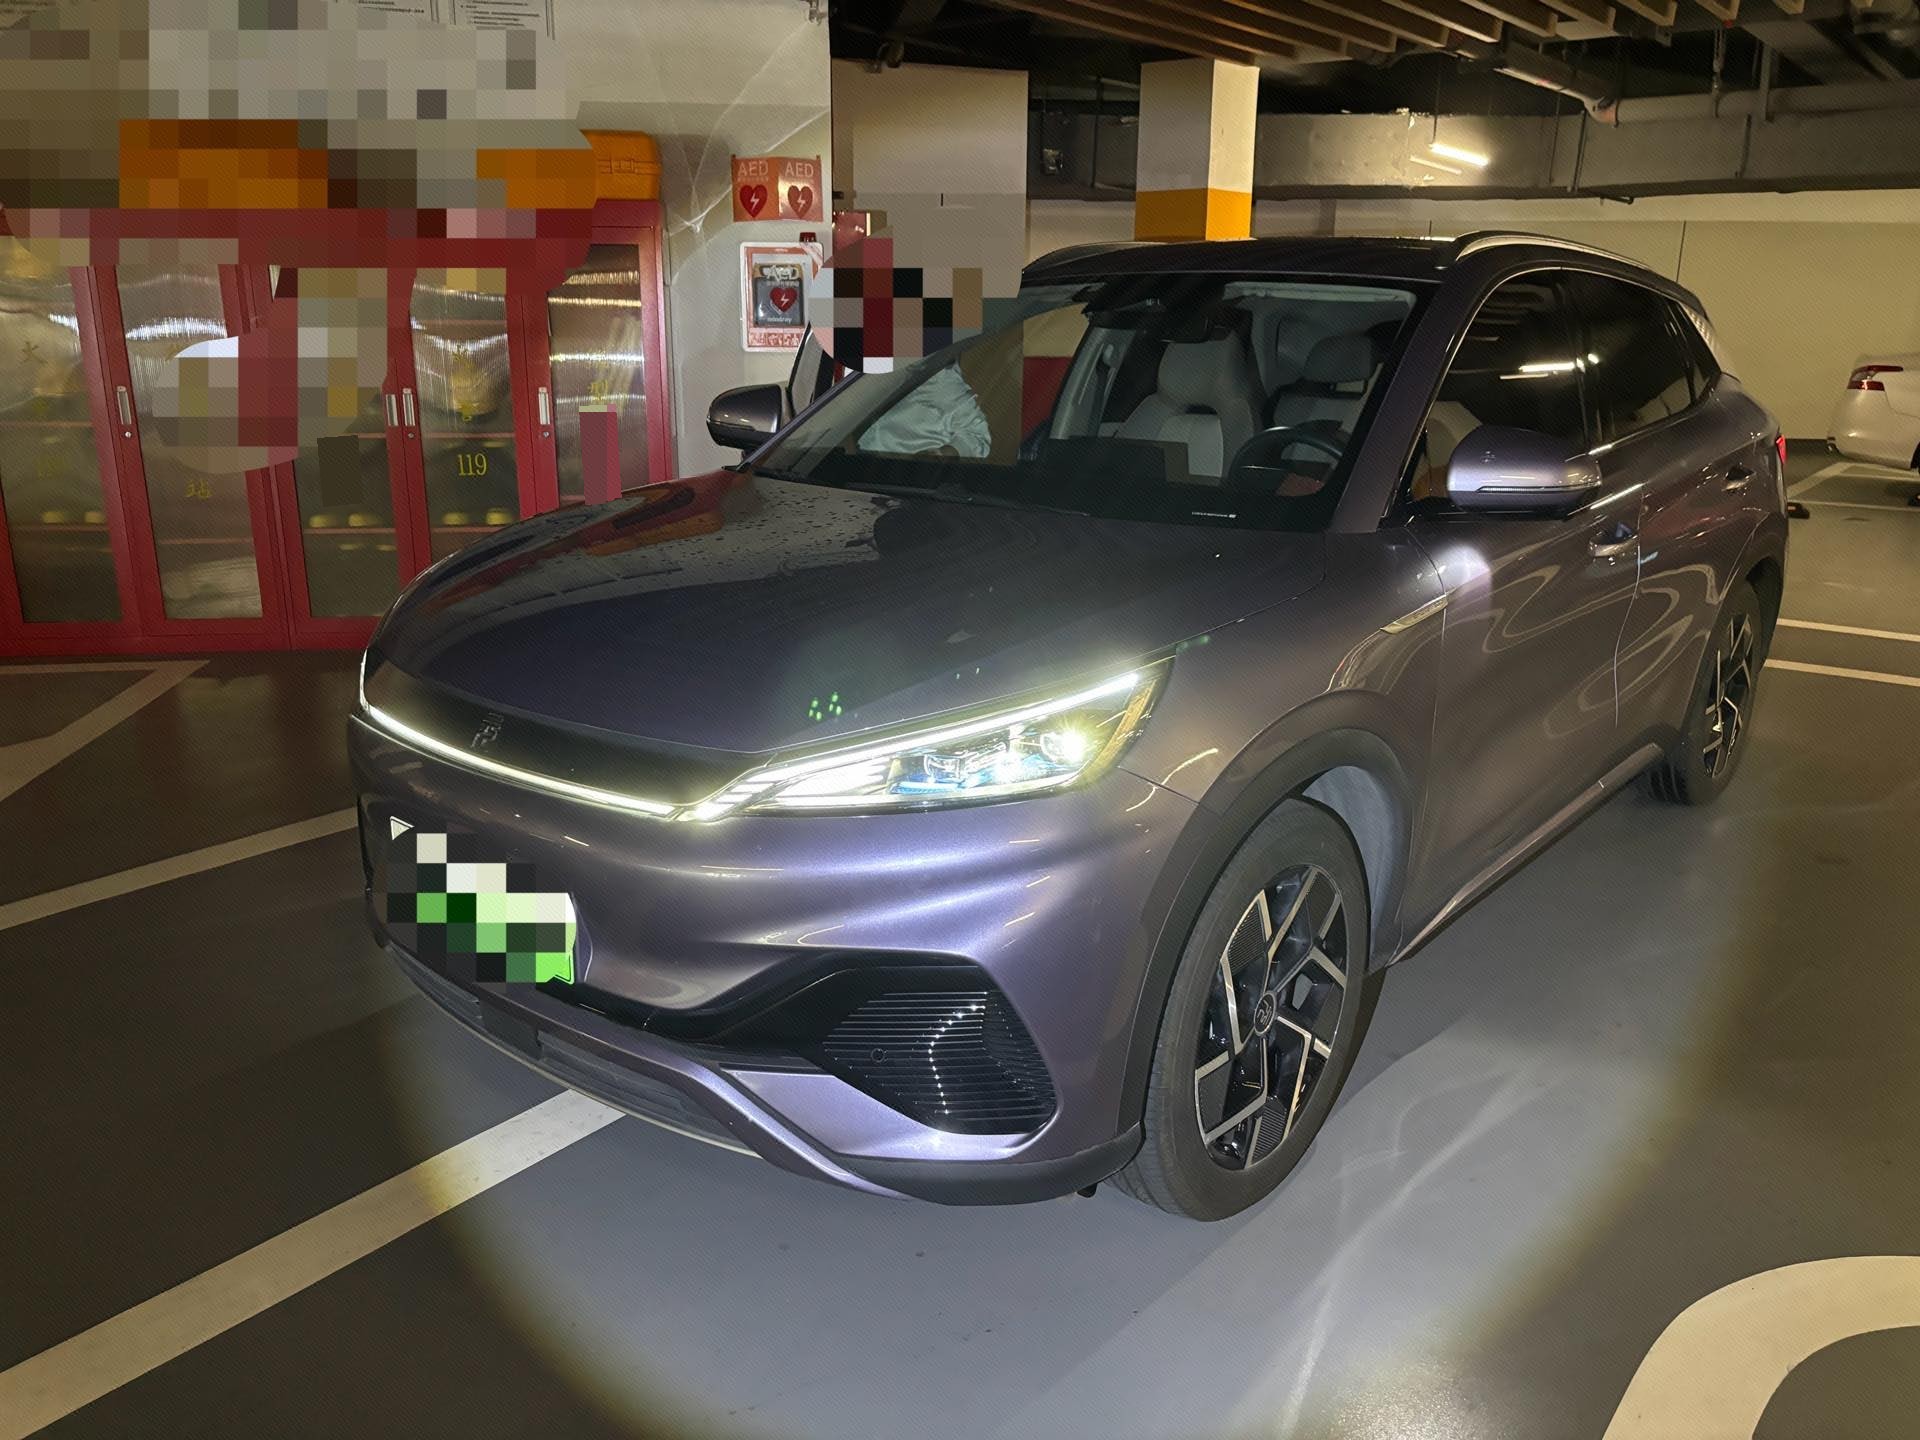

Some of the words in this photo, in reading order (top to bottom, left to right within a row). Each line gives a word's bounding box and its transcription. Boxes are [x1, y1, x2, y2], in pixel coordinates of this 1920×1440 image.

[737, 160, 769, 177] AED
[785, 161, 814, 178] AED
[458, 453, 487, 476] 119
